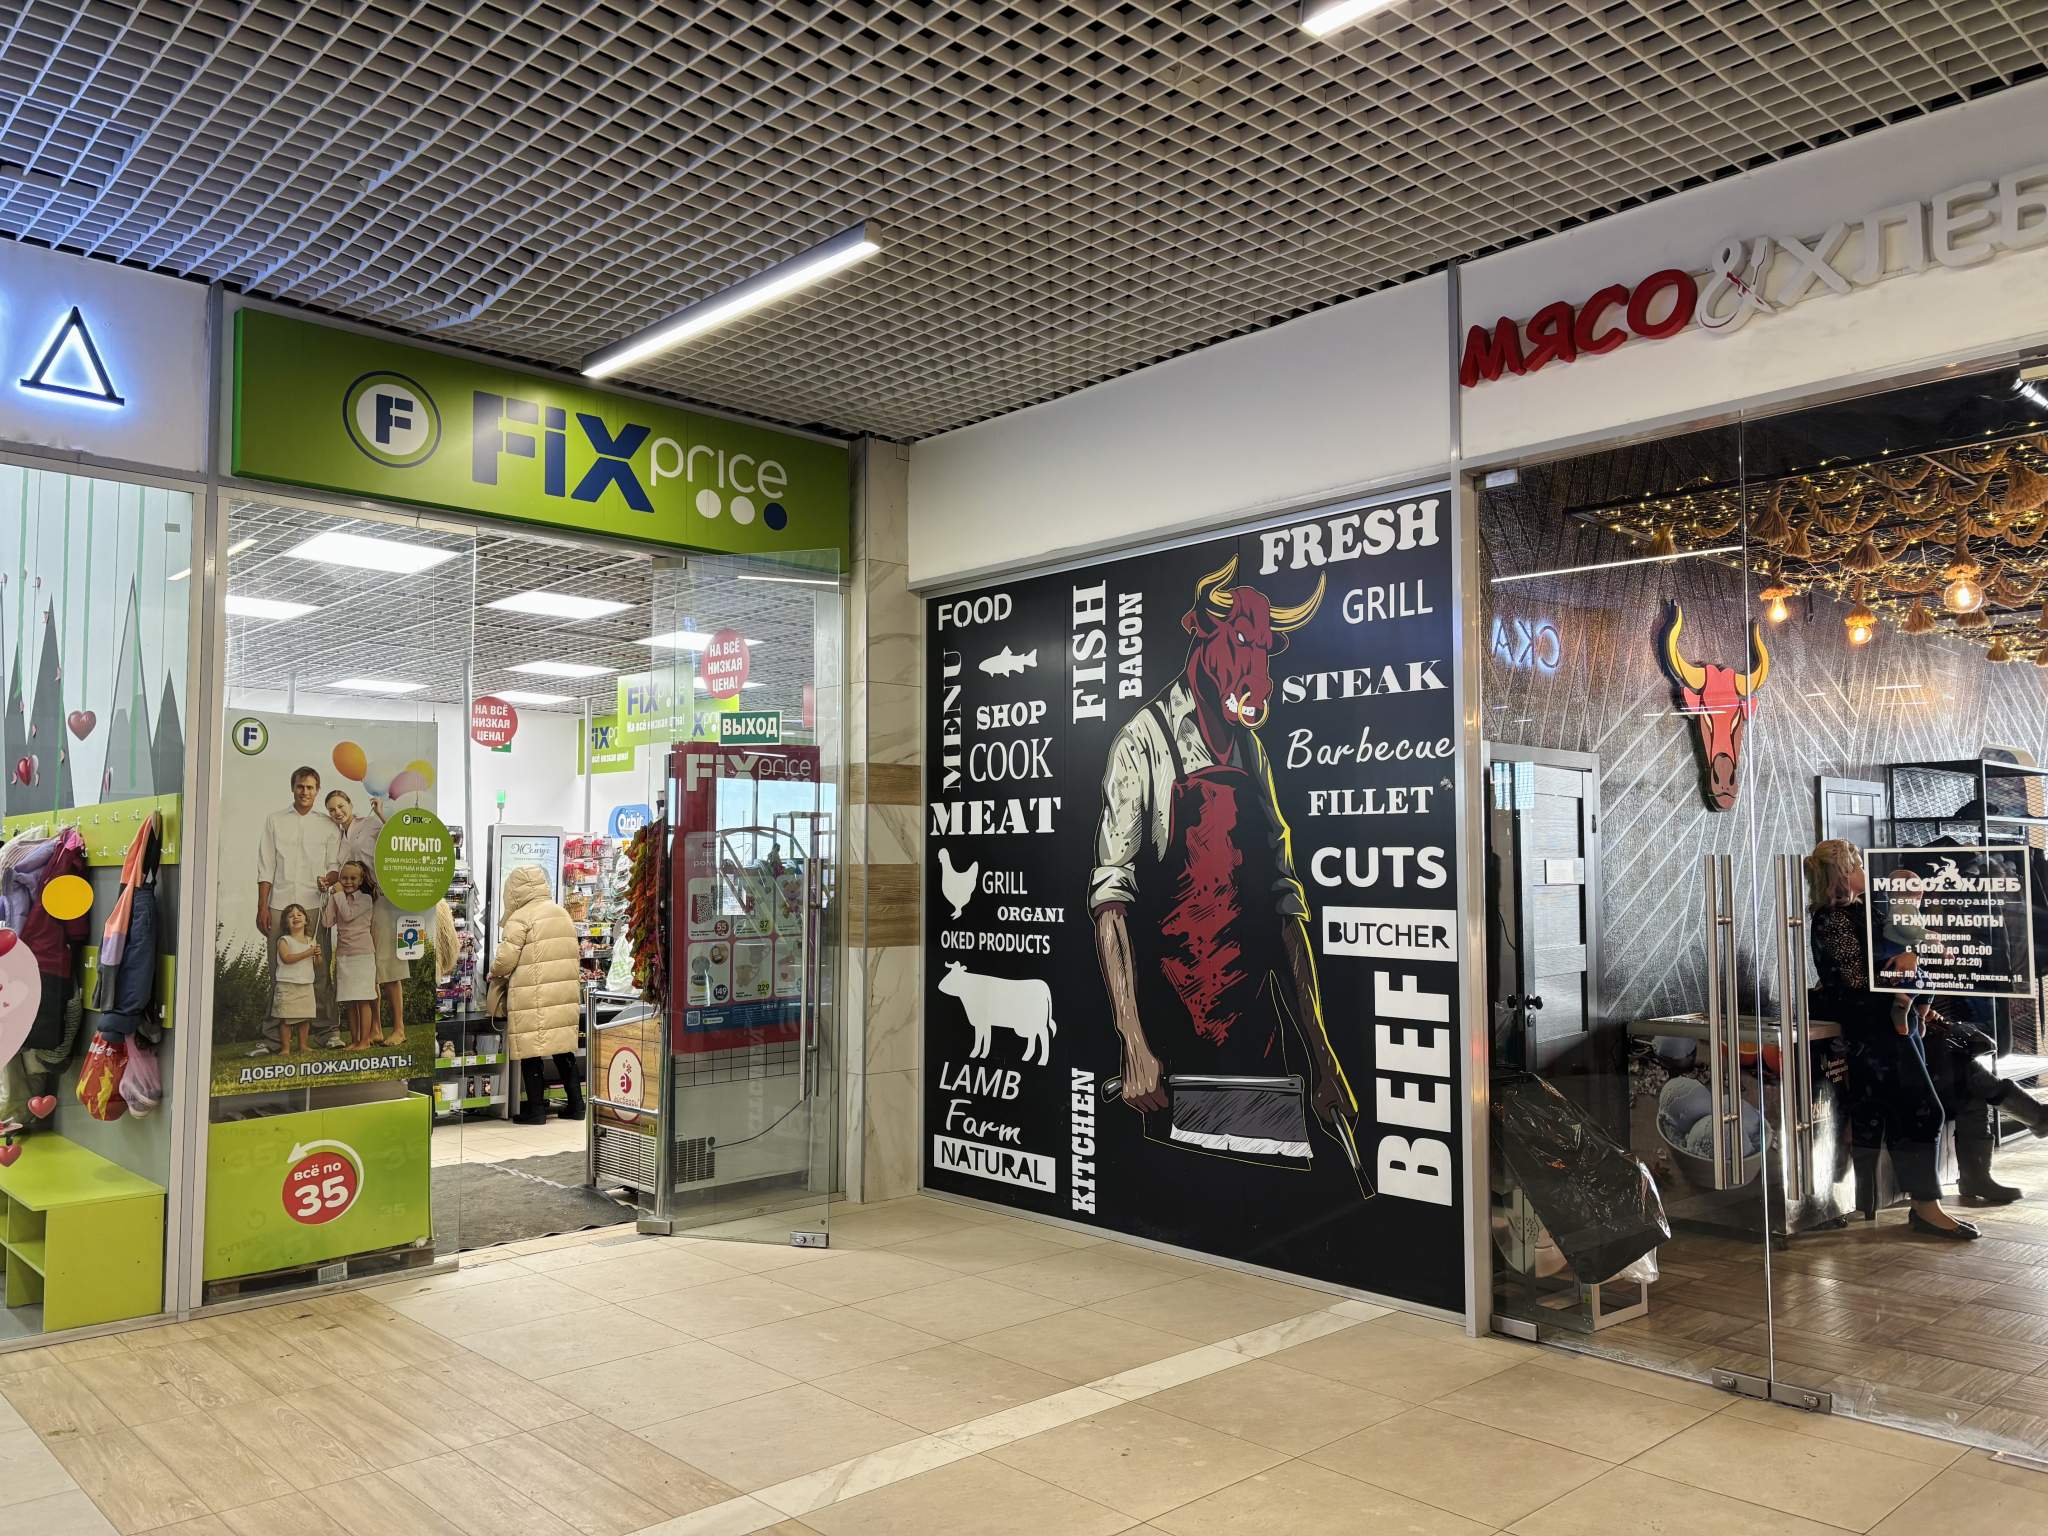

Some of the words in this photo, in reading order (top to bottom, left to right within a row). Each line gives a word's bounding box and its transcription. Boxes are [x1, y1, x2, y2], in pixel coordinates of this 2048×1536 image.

[375, 393, 413, 444] F
[651, 436, 788, 500] price
[1259, 499, 1440, 576] FRESH
[938, 593, 1012, 631] FOOD
[1342, 579, 1433, 625] GRILL
[709, 644, 722, 657] НА
[723, 638, 740, 654] ВСЁ
[1072, 580, 1107, 724] FISH
[1118, 592, 1143, 699] BACON
[707, 658, 743, 675] НИЗКАЯ
[712, 676, 738, 693] ЦЕНА!
[1282, 659, 1449, 705] STEAK
[472, 717, 511, 729] НИЗКАЯ
[475, 705, 487, 715] НА
[490, 704, 508, 716] ВСЁ
[943, 648, 962, 793] MENU
[976, 700, 1047, 731] SHOP
[243, 727, 258, 747] F
[477, 731, 505, 741] ЦЕНА!
[722, 717, 778, 738] ВЫХОД
[969, 737, 1053, 783] COOK
[1286, 726, 1455, 770] Barbecue
[758, 758, 811, 779] price
[929, 797, 1062, 836] MEAT
[1307, 786, 1434, 817] FILLET
[390, 836, 442, 853] ОТКРЫТО
[1310, 846, 1448, 889] CUTS
[982, 871, 1028, 895] GRILL
[997, 905, 1065, 923] ORGANI
[1924, 898, 2005, 907] ресторанов
[1328, 921, 1450, 950] BUTCHER
[1893, 914, 1943, 927] РЕЖИМ
[1947, 914, 2004, 927] РАБОТЫ
[940, 930, 975, 949] OKED
[978, 932, 1051, 955] PRODUCTS
[1915, 943, 1943, 954] 10:00
[1946, 945, 1960, 956] до
[1962, 945, 1993, 956] 00:00
[1925, 933, 1971, 942] ежедневно
[1944, 957, 1955, 966] до
[240, 1063, 296, 1084] ДОБРО
[299, 1054, 413, 1076] ПОЖАЛОВАТЬ!
[939, 1061, 1022, 1100] LAMB
[1374, 970, 1453, 1207] BEEF
[945, 1099, 1022, 1145] Farm
[1071, 1067, 1096, 1215] KITCHEN
[293, 1164, 320, 1182] всё
[323, 1162, 342, 1175] по
[940, 1140, 1047, 1186] NATURAL
[294, 1175, 349, 1217] 35
